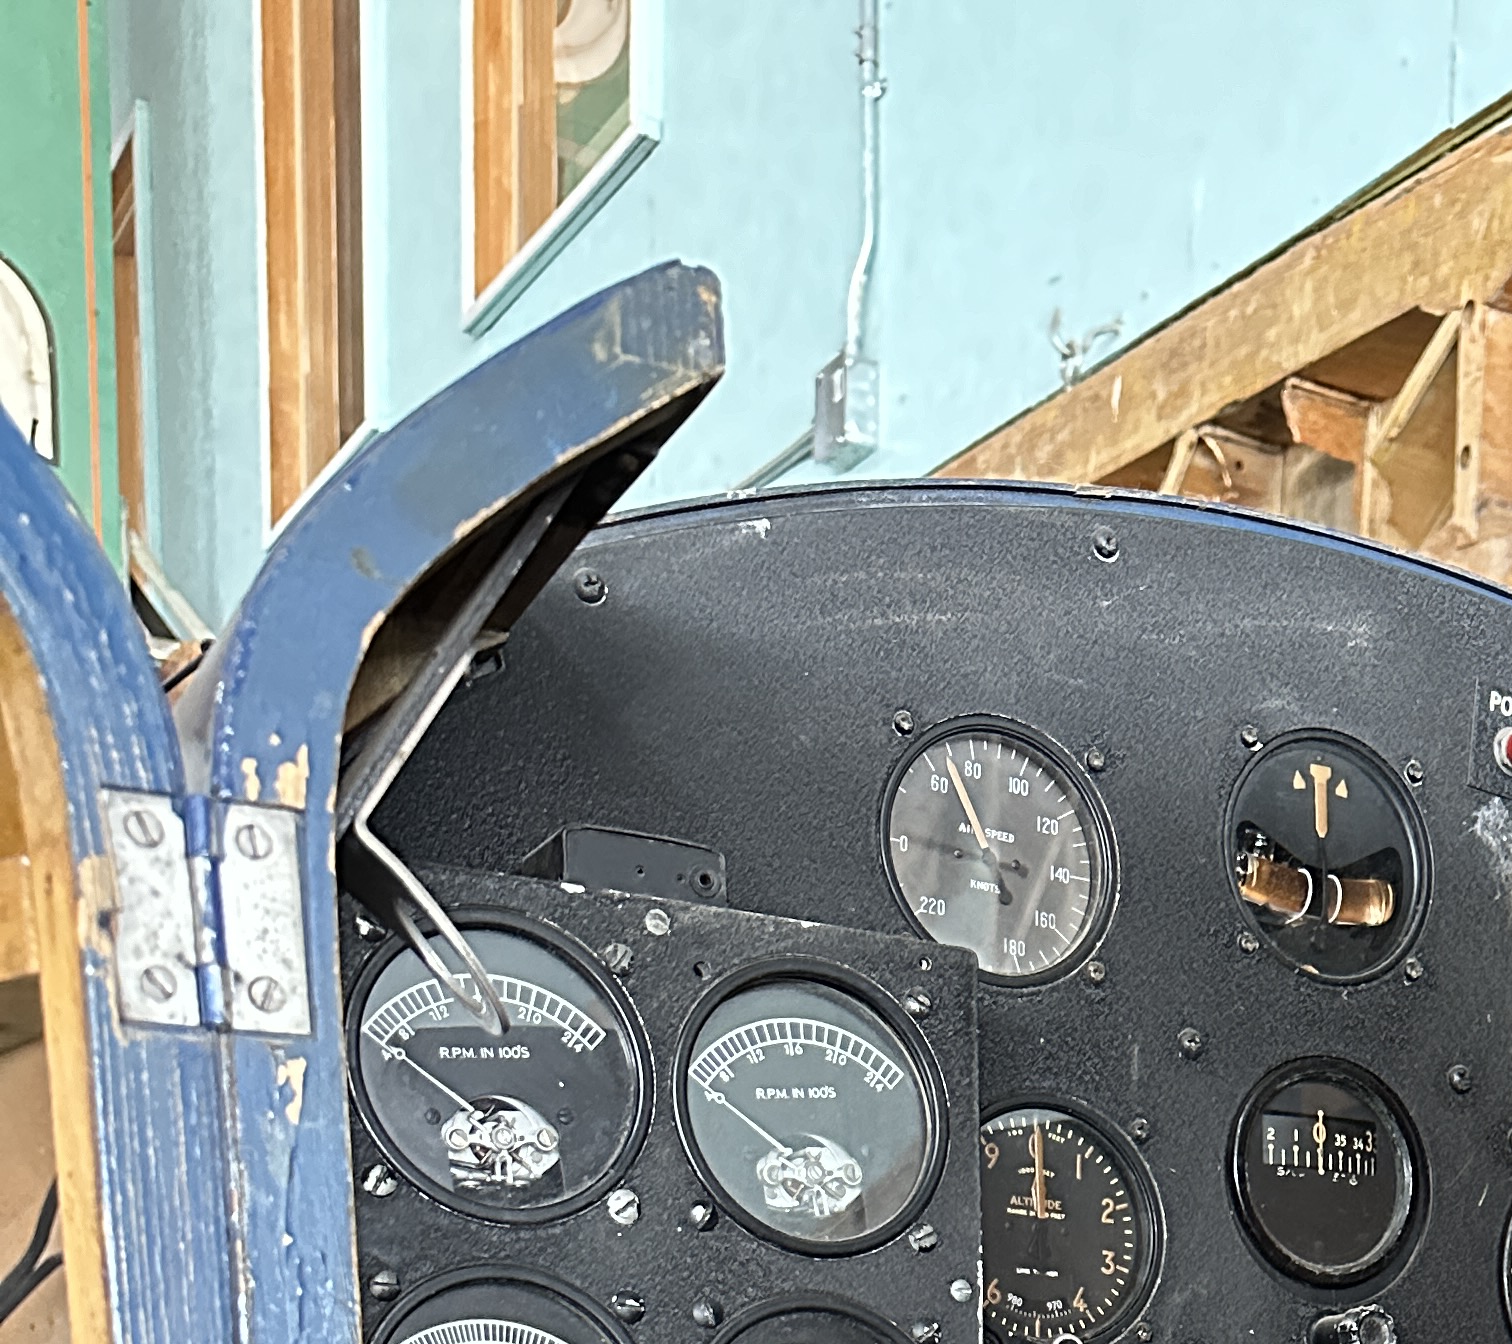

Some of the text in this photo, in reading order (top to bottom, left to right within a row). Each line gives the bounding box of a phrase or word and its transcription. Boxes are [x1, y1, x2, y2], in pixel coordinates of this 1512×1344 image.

[964, 760, 982, 779] 80
[930, 774, 949, 794] 60
[1008, 776, 1029, 797] 100
[958, 822, 1015, 844] AI SPEED
[1036, 815, 1059, 836] 120
[899, 835, 909, 852] 0
[1050, 865, 1070, 884] 140
[970, 878, 1001, 894] KNOTS
[919, 896, 946, 916] 220
[1034, 910, 1056, 930] 160
[1003, 937, 1026, 957] 180
[439, 1046, 478, 1059] R.P.M.
[480, 1046, 495, 1059] IN
[755, 1087, 789, 1099] R.P.M.
[792, 1088, 805, 1099] IN
[1266, 1127, 1276, 1141] 2
[1293, 1128, 1299, 1142] 1
[1312, 1122, 1327, 1144] 0
[1334, 1133, 1347, 1147] 35
[1352, 1137, 1364, 1151] 34
[985, 1142, 1000, 1169] 9
[1075, 1153, 1082, 1180] 1
[1009, 1195, 1062, 1211] ALTIDE
[1101, 1197, 1115, 1224] 2
[1101, 1250, 1116, 1275] 3
[986, 1278, 1002, 1304] 6
[1072, 1287, 1088, 1312] 4
[1046, 1300, 1063, 1311] 970
